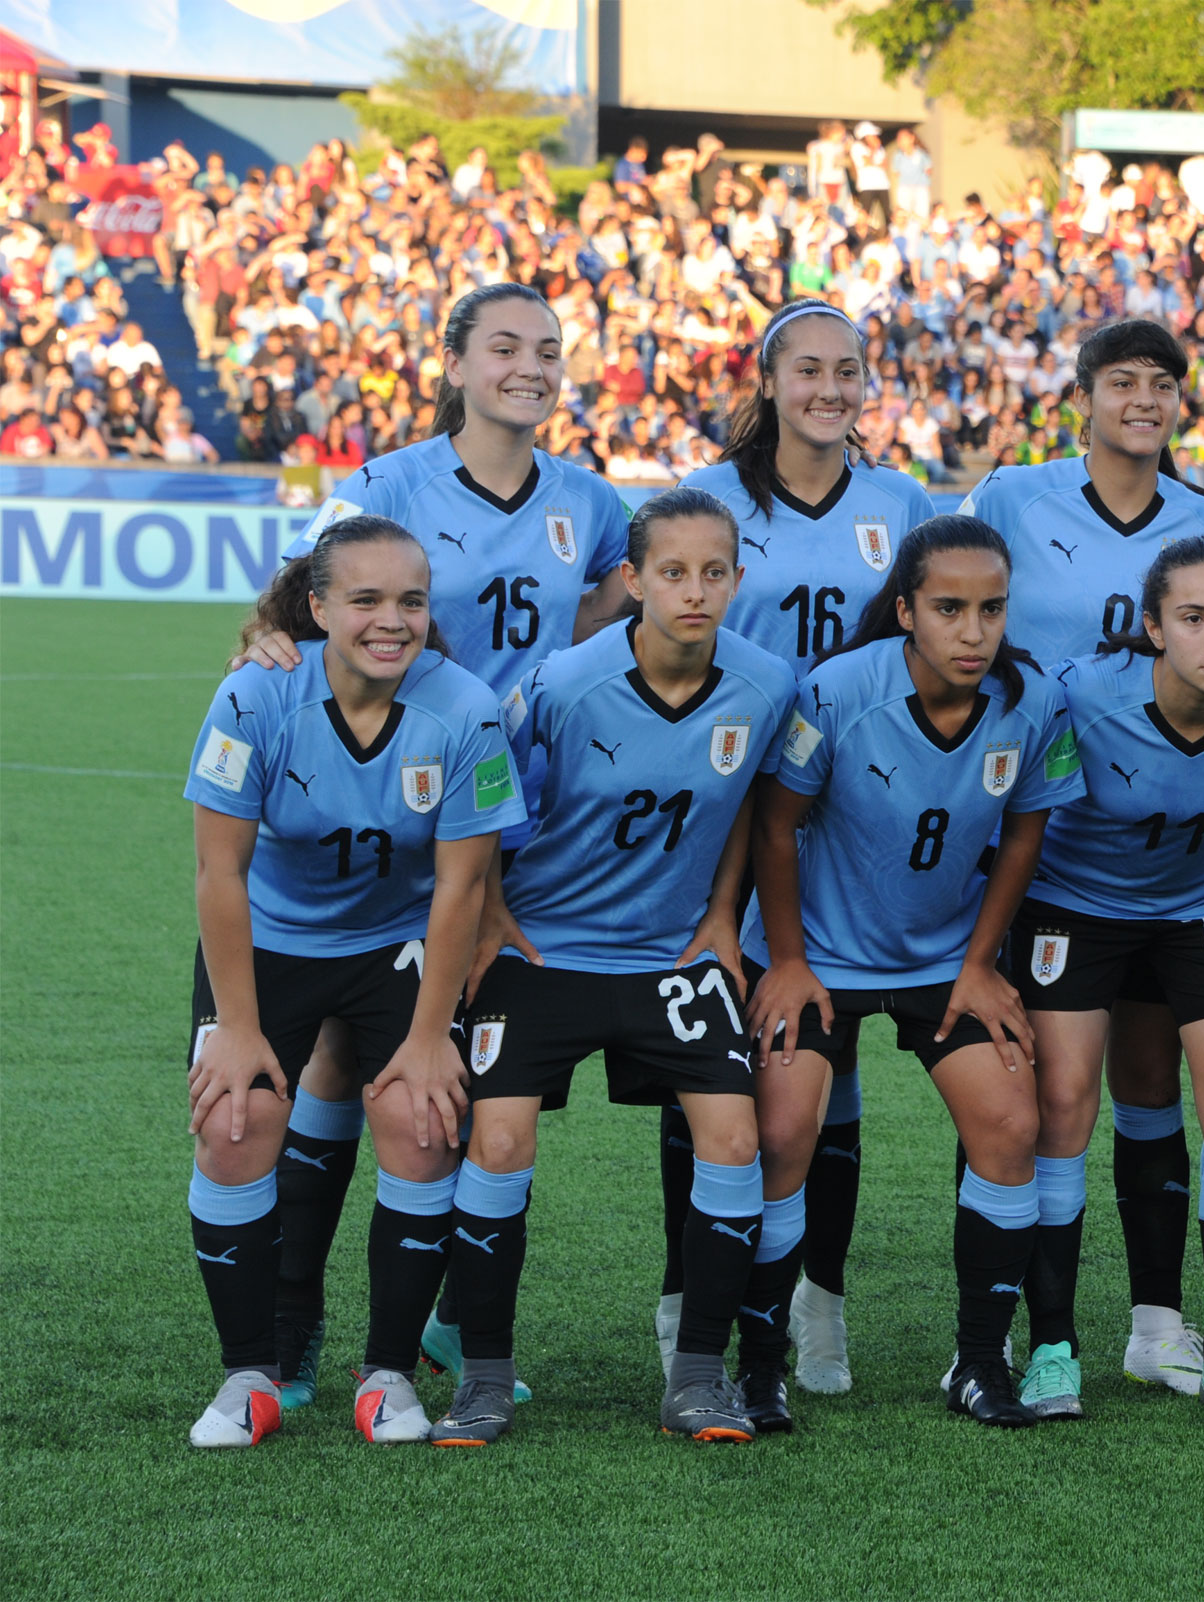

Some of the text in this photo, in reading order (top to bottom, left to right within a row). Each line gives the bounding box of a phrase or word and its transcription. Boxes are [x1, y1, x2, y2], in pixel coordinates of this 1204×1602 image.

[1, 508, 315, 592] MON
[477, 576, 540, 651] 15
[779, 584, 845, 658] 16
[318, 827, 394, 879] 17
[613, 789, 693, 853] 21
[908, 808, 950, 872] 8
[657, 968, 743, 1042] 21
